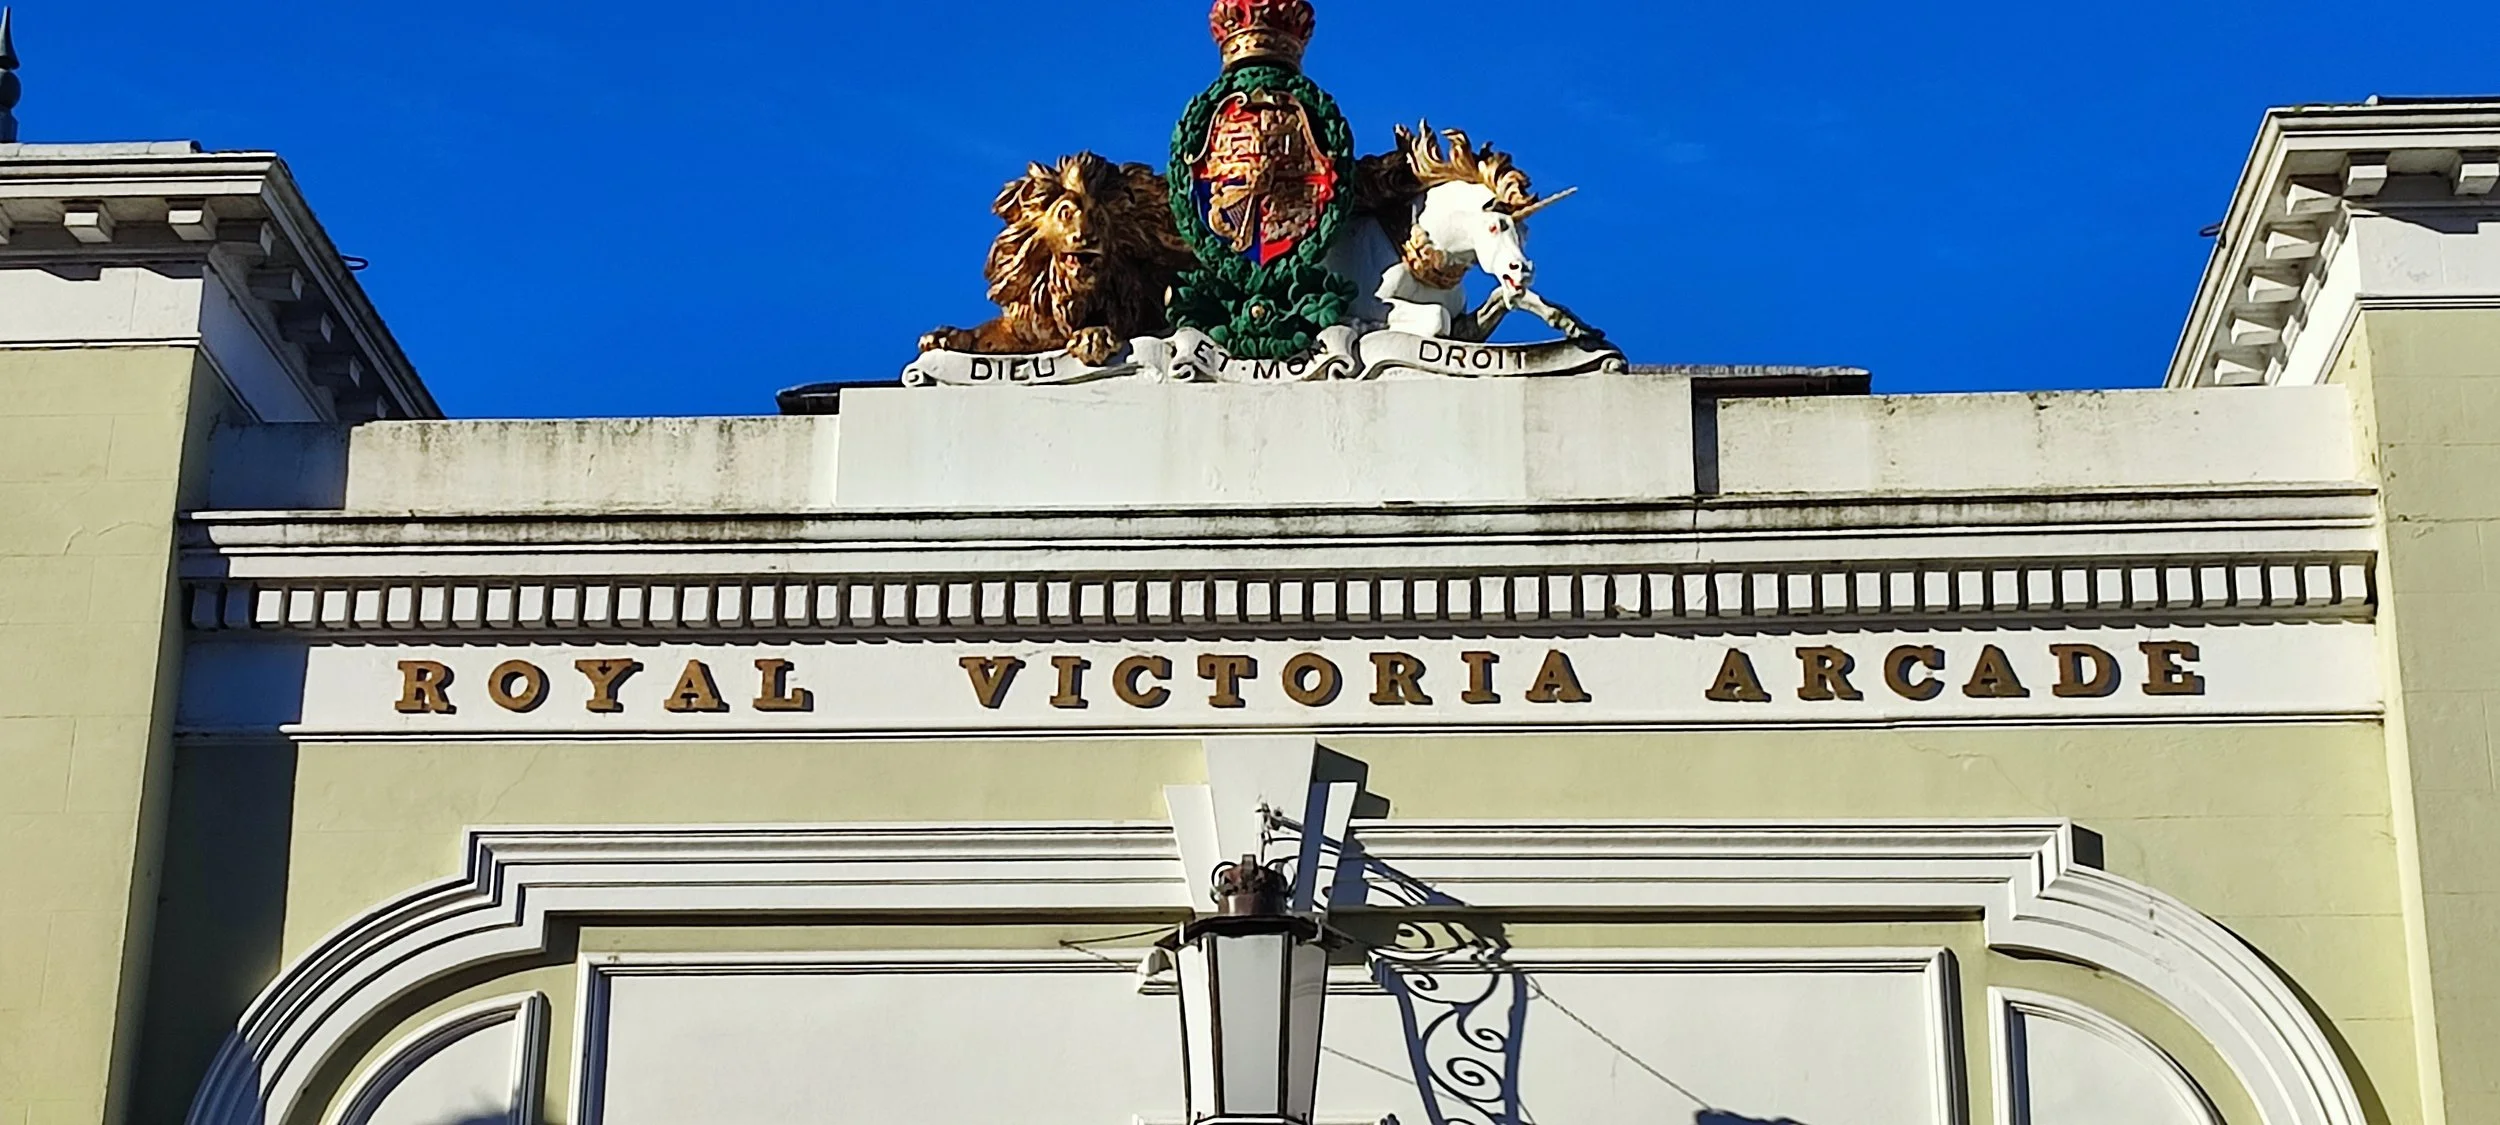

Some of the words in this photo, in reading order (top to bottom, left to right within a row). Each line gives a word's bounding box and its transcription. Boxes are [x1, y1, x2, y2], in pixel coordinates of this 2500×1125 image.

[970, 356, 1055, 381] DIEU
[1419, 339, 1527, 369] DROIT
[395, 659, 814, 714] ROYAL
[959, 649, 1593, 709] VICTORIA
[1705, 640, 2206, 702] ARCADE
